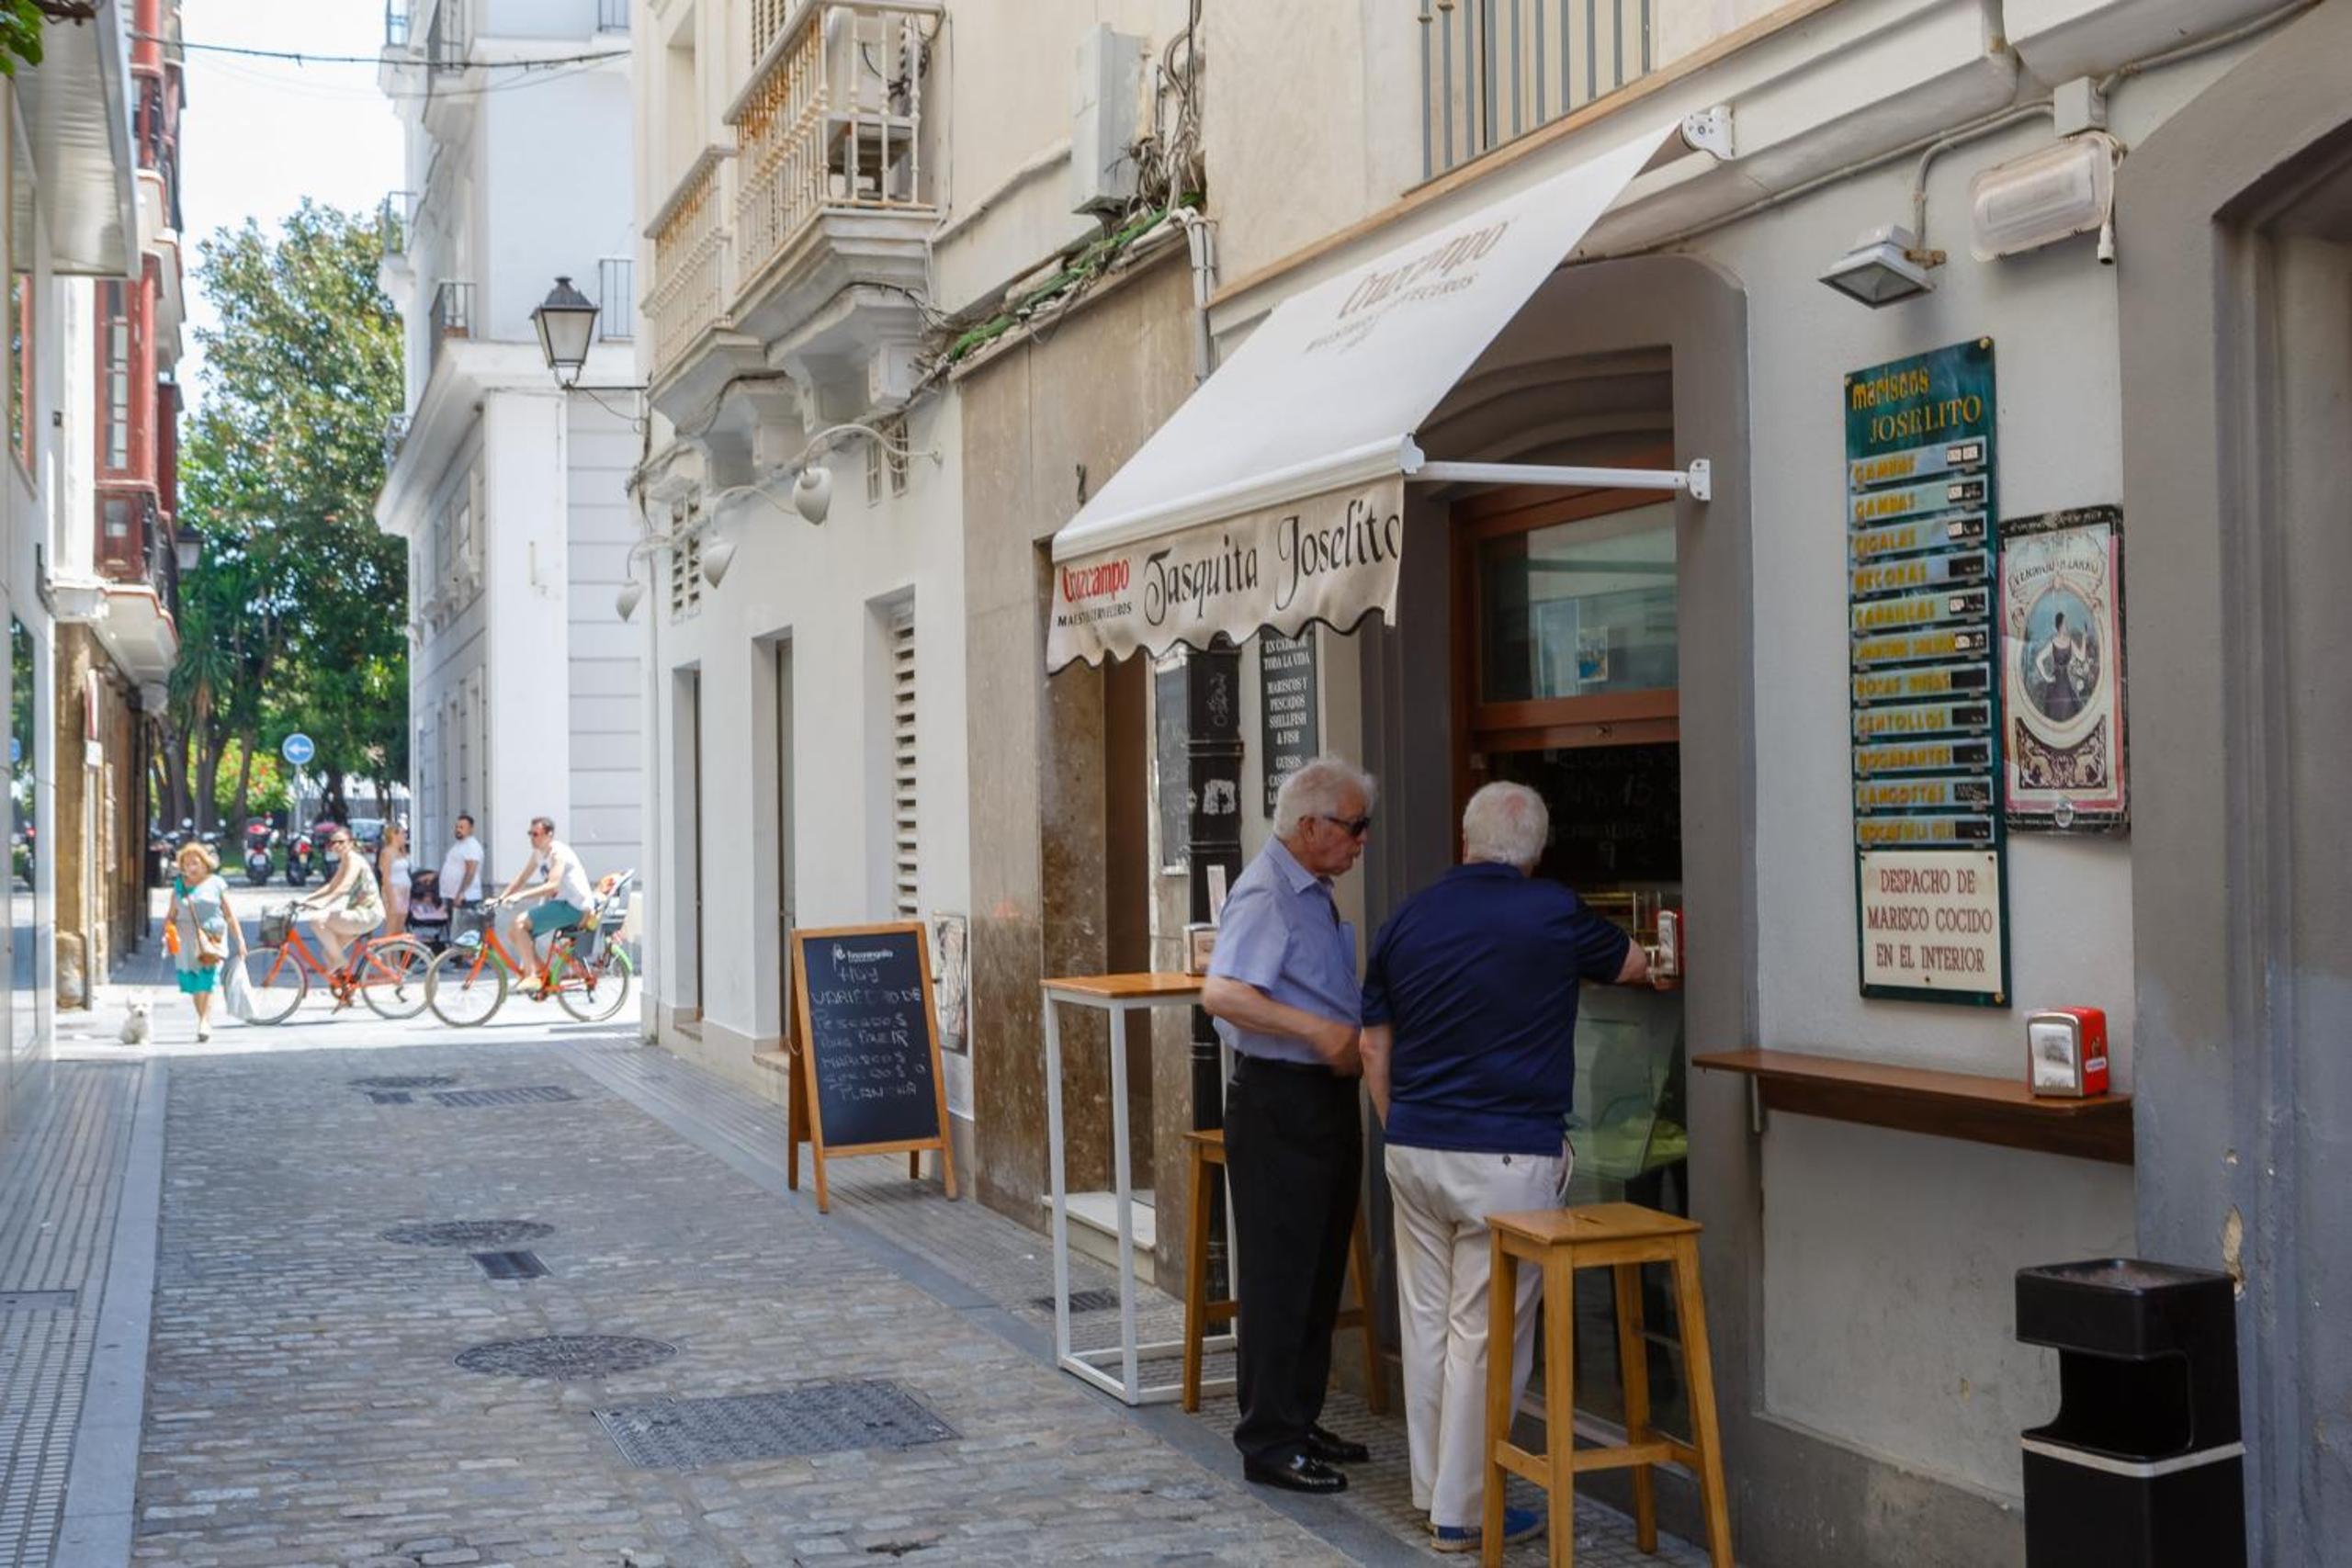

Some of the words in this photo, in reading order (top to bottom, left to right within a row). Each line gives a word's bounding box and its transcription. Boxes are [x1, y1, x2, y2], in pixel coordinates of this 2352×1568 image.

[1870, 395, 1982, 444] JOSELITO
[1145, 535, 1258, 626] Tasquita
[1881, 869, 1951, 894] DESPACHO
[1957, 869, 1975, 894] DE
[1867, 905, 1929, 931] MARISCO
[1936, 907, 1993, 934] COCIDO
[1876, 943, 1894, 967] EN
[1900, 944, 1915, 968] EL
[1920, 945, 1985, 973] INTERIOR
